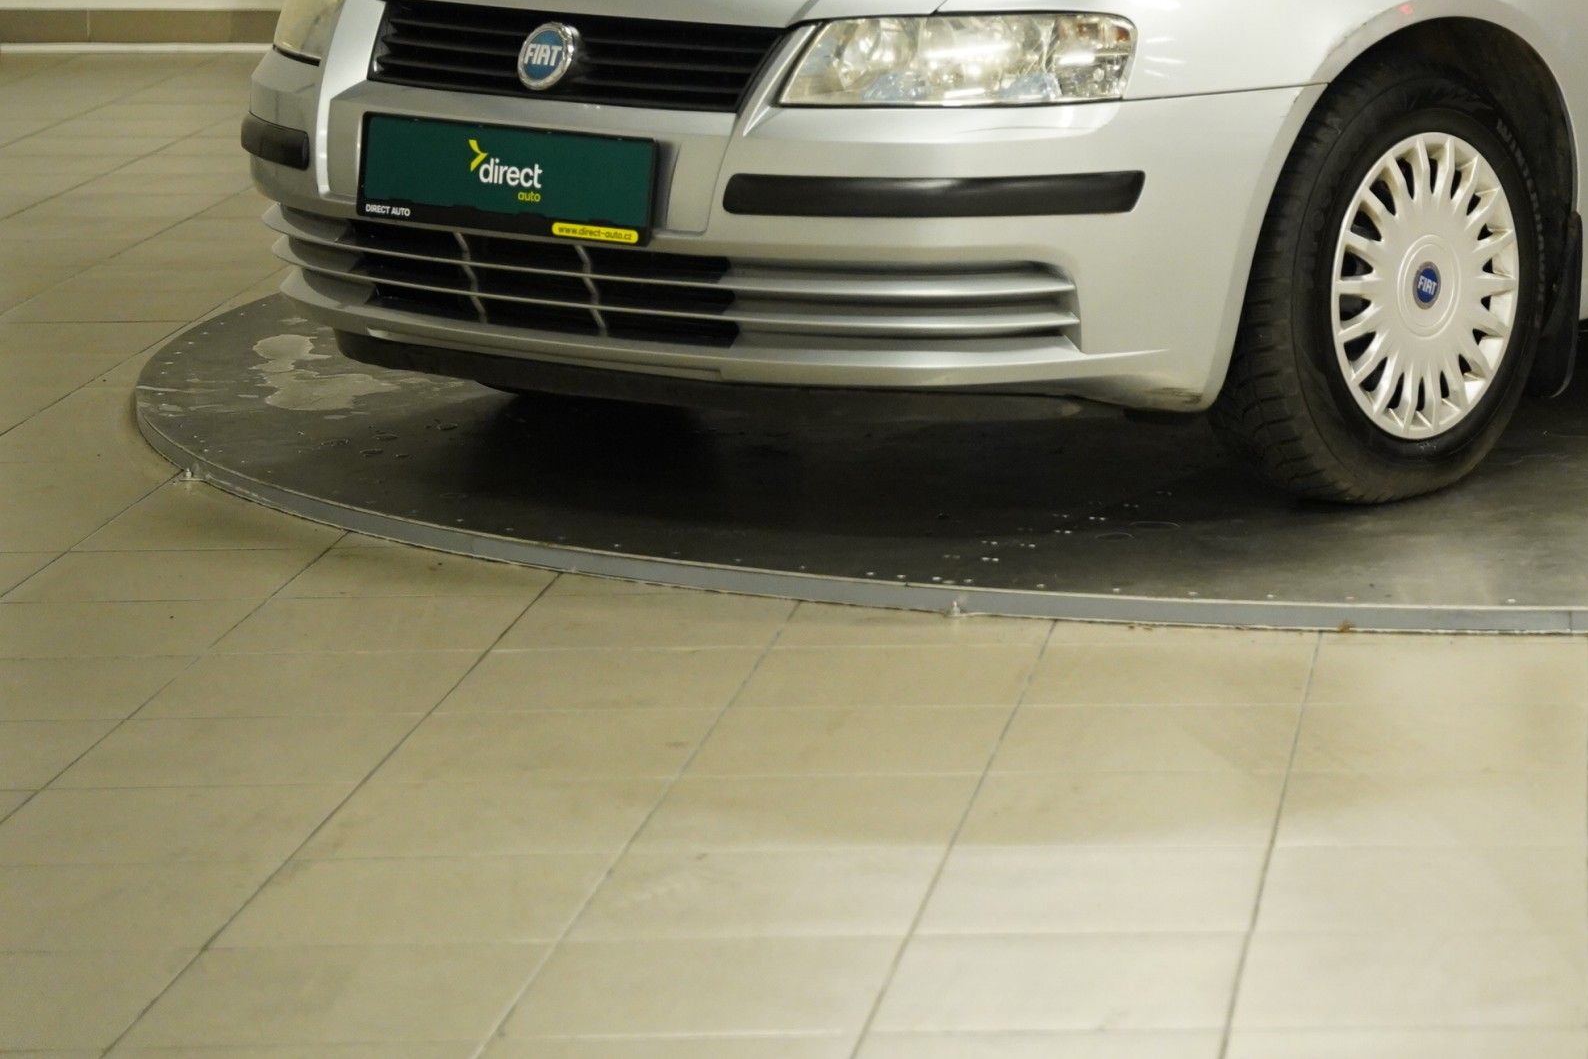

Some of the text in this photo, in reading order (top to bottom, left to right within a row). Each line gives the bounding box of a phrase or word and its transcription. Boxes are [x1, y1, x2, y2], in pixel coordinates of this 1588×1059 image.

[524, 43, 562, 66] FIAT
[479, 157, 543, 189] direct
[517, 191, 541, 202] auto
[365, 203, 411, 217] DIRECT AUTO
[558, 226, 632, 240] www.direct-auto.cz
[1417, 275, 1437, 296] FIAT
